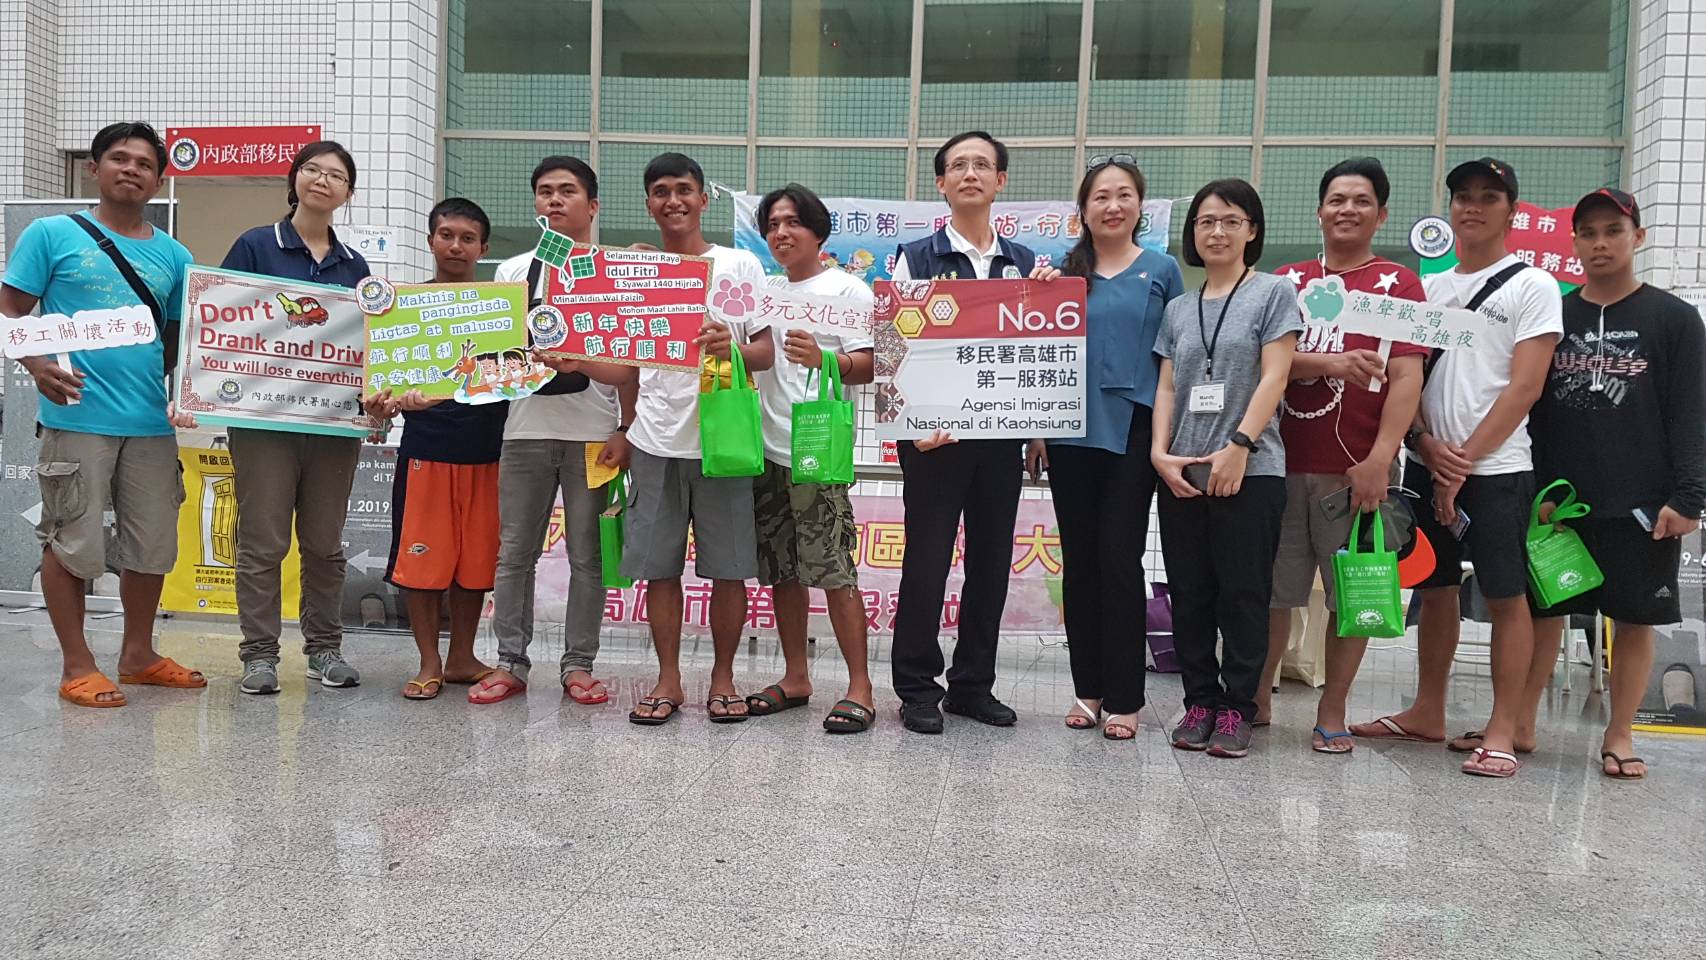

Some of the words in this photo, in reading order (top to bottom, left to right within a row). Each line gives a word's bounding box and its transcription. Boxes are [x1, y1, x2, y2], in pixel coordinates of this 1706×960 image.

[202, 143, 307, 165] 內政部移民
[606, 252, 640, 261] Selamat
[641, 254, 659, 262] Hari
[660, 255, 680, 263] Raya
[607, 267, 629, 276] Idul
[633, 267, 657, 277] Fitri
[622, 280, 650, 289] Syawal
[674, 280, 702, 289] Hijriah
[399, 291, 455, 307] Makinis
[461, 290, 478, 300] na
[621, 294, 644, 302] Faizin
[200, 299, 275, 324] Don't
[422, 299, 510, 320] pangingisda
[667, 305, 687, 313] Lahir
[998, 301, 1081, 331] No.6
[1353, 295, 1443, 329] 漁聲歡唱
[8, 318, 152, 346] 移工關懷活動
[371, 324, 418, 341] Ligtas
[426, 326, 442, 336] at
[452, 319, 512, 335] malusog
[574, 313, 669, 336] 新年快樂
[200, 327, 268, 352] Drank
[274, 340, 314, 358] and
[1410, 324, 1475, 348] 高雄夜
[370, 343, 451, 363] 航行順利
[585, 337, 686, 359] 航行順利
[956, 344, 1078, 364] 移民署高雄市
[201, 355, 229, 370] You
[234, 360, 259, 374] will
[264, 362, 293, 377] lose
[370, 366, 441, 389] 平安健康
[976, 369, 1078, 389] 第一服務站
[961, 398, 1016, 412] Agensi
[1021, 397, 1081, 412] Imigrasi
[906, 417, 973, 430] Nasional
[979, 417, 992, 429] di
[998, 416, 1081, 430] Kaohsiung
[373, 473, 383, 482] di
